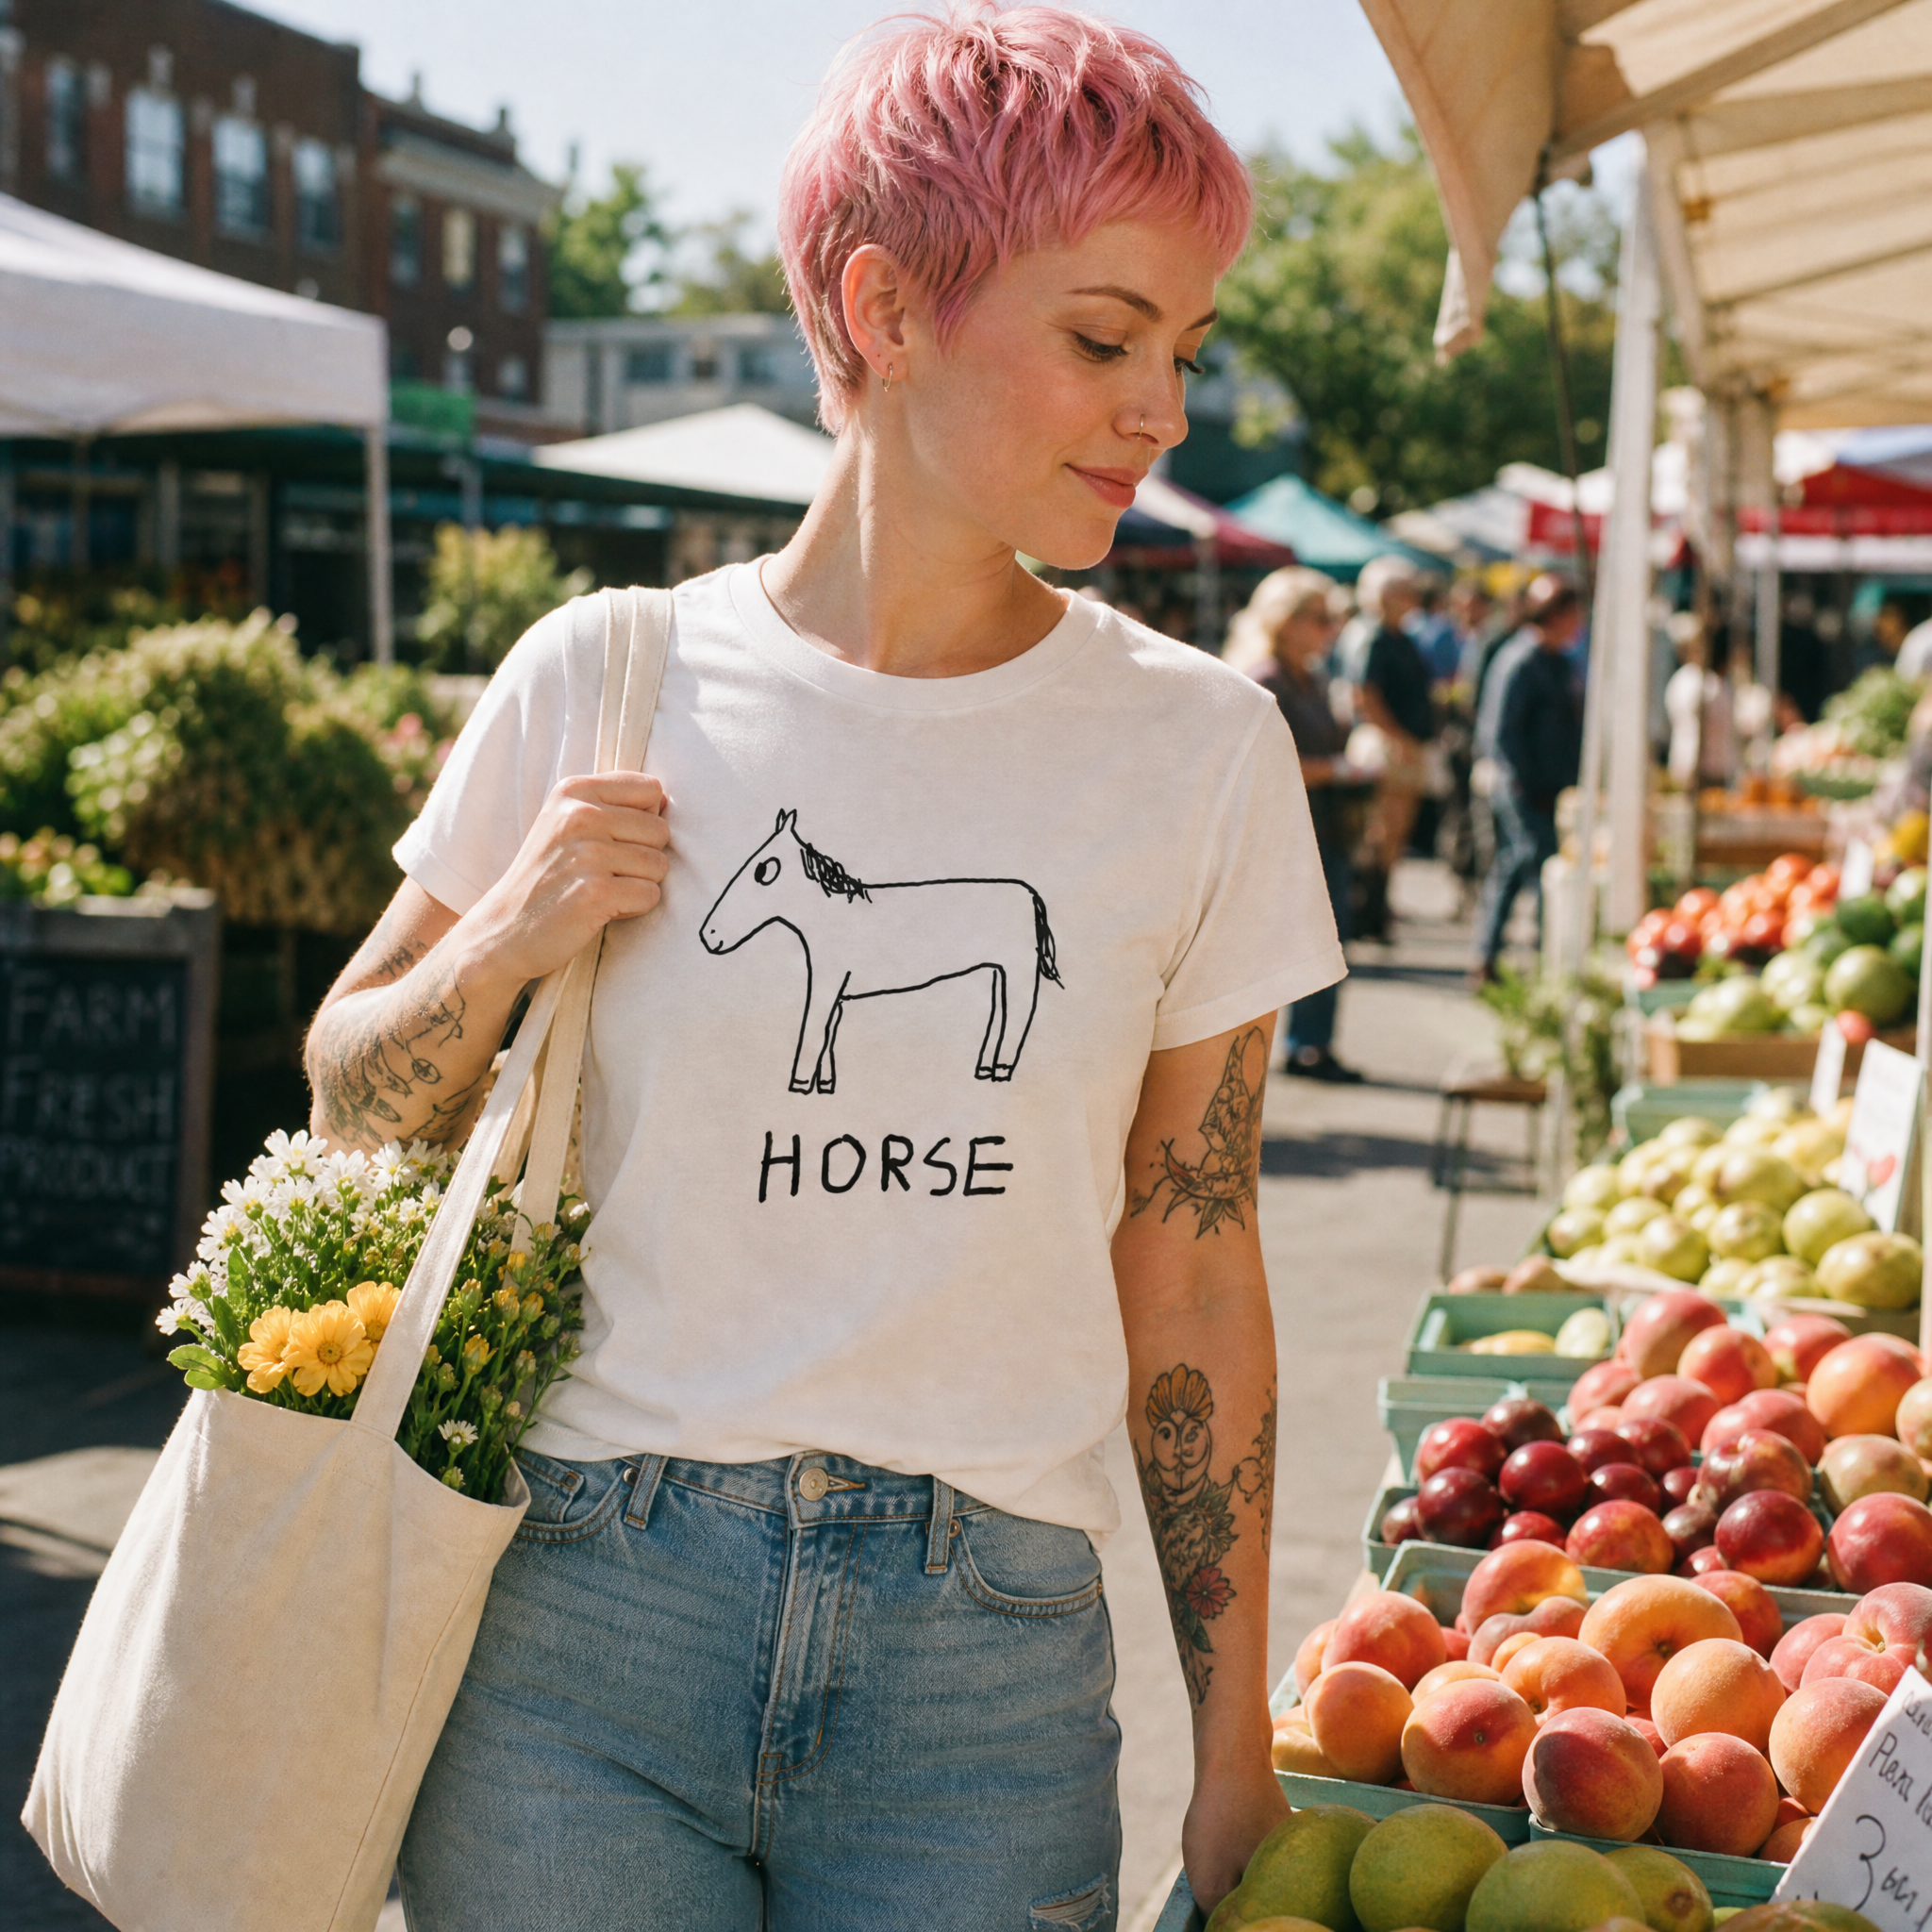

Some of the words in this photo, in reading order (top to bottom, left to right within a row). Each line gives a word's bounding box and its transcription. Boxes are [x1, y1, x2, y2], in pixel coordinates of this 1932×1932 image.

[8, 969, 177, 1050] FARM
[1, 1054, 175, 1140] FRESH
[758, 1131, 1013, 1203] HORSE
